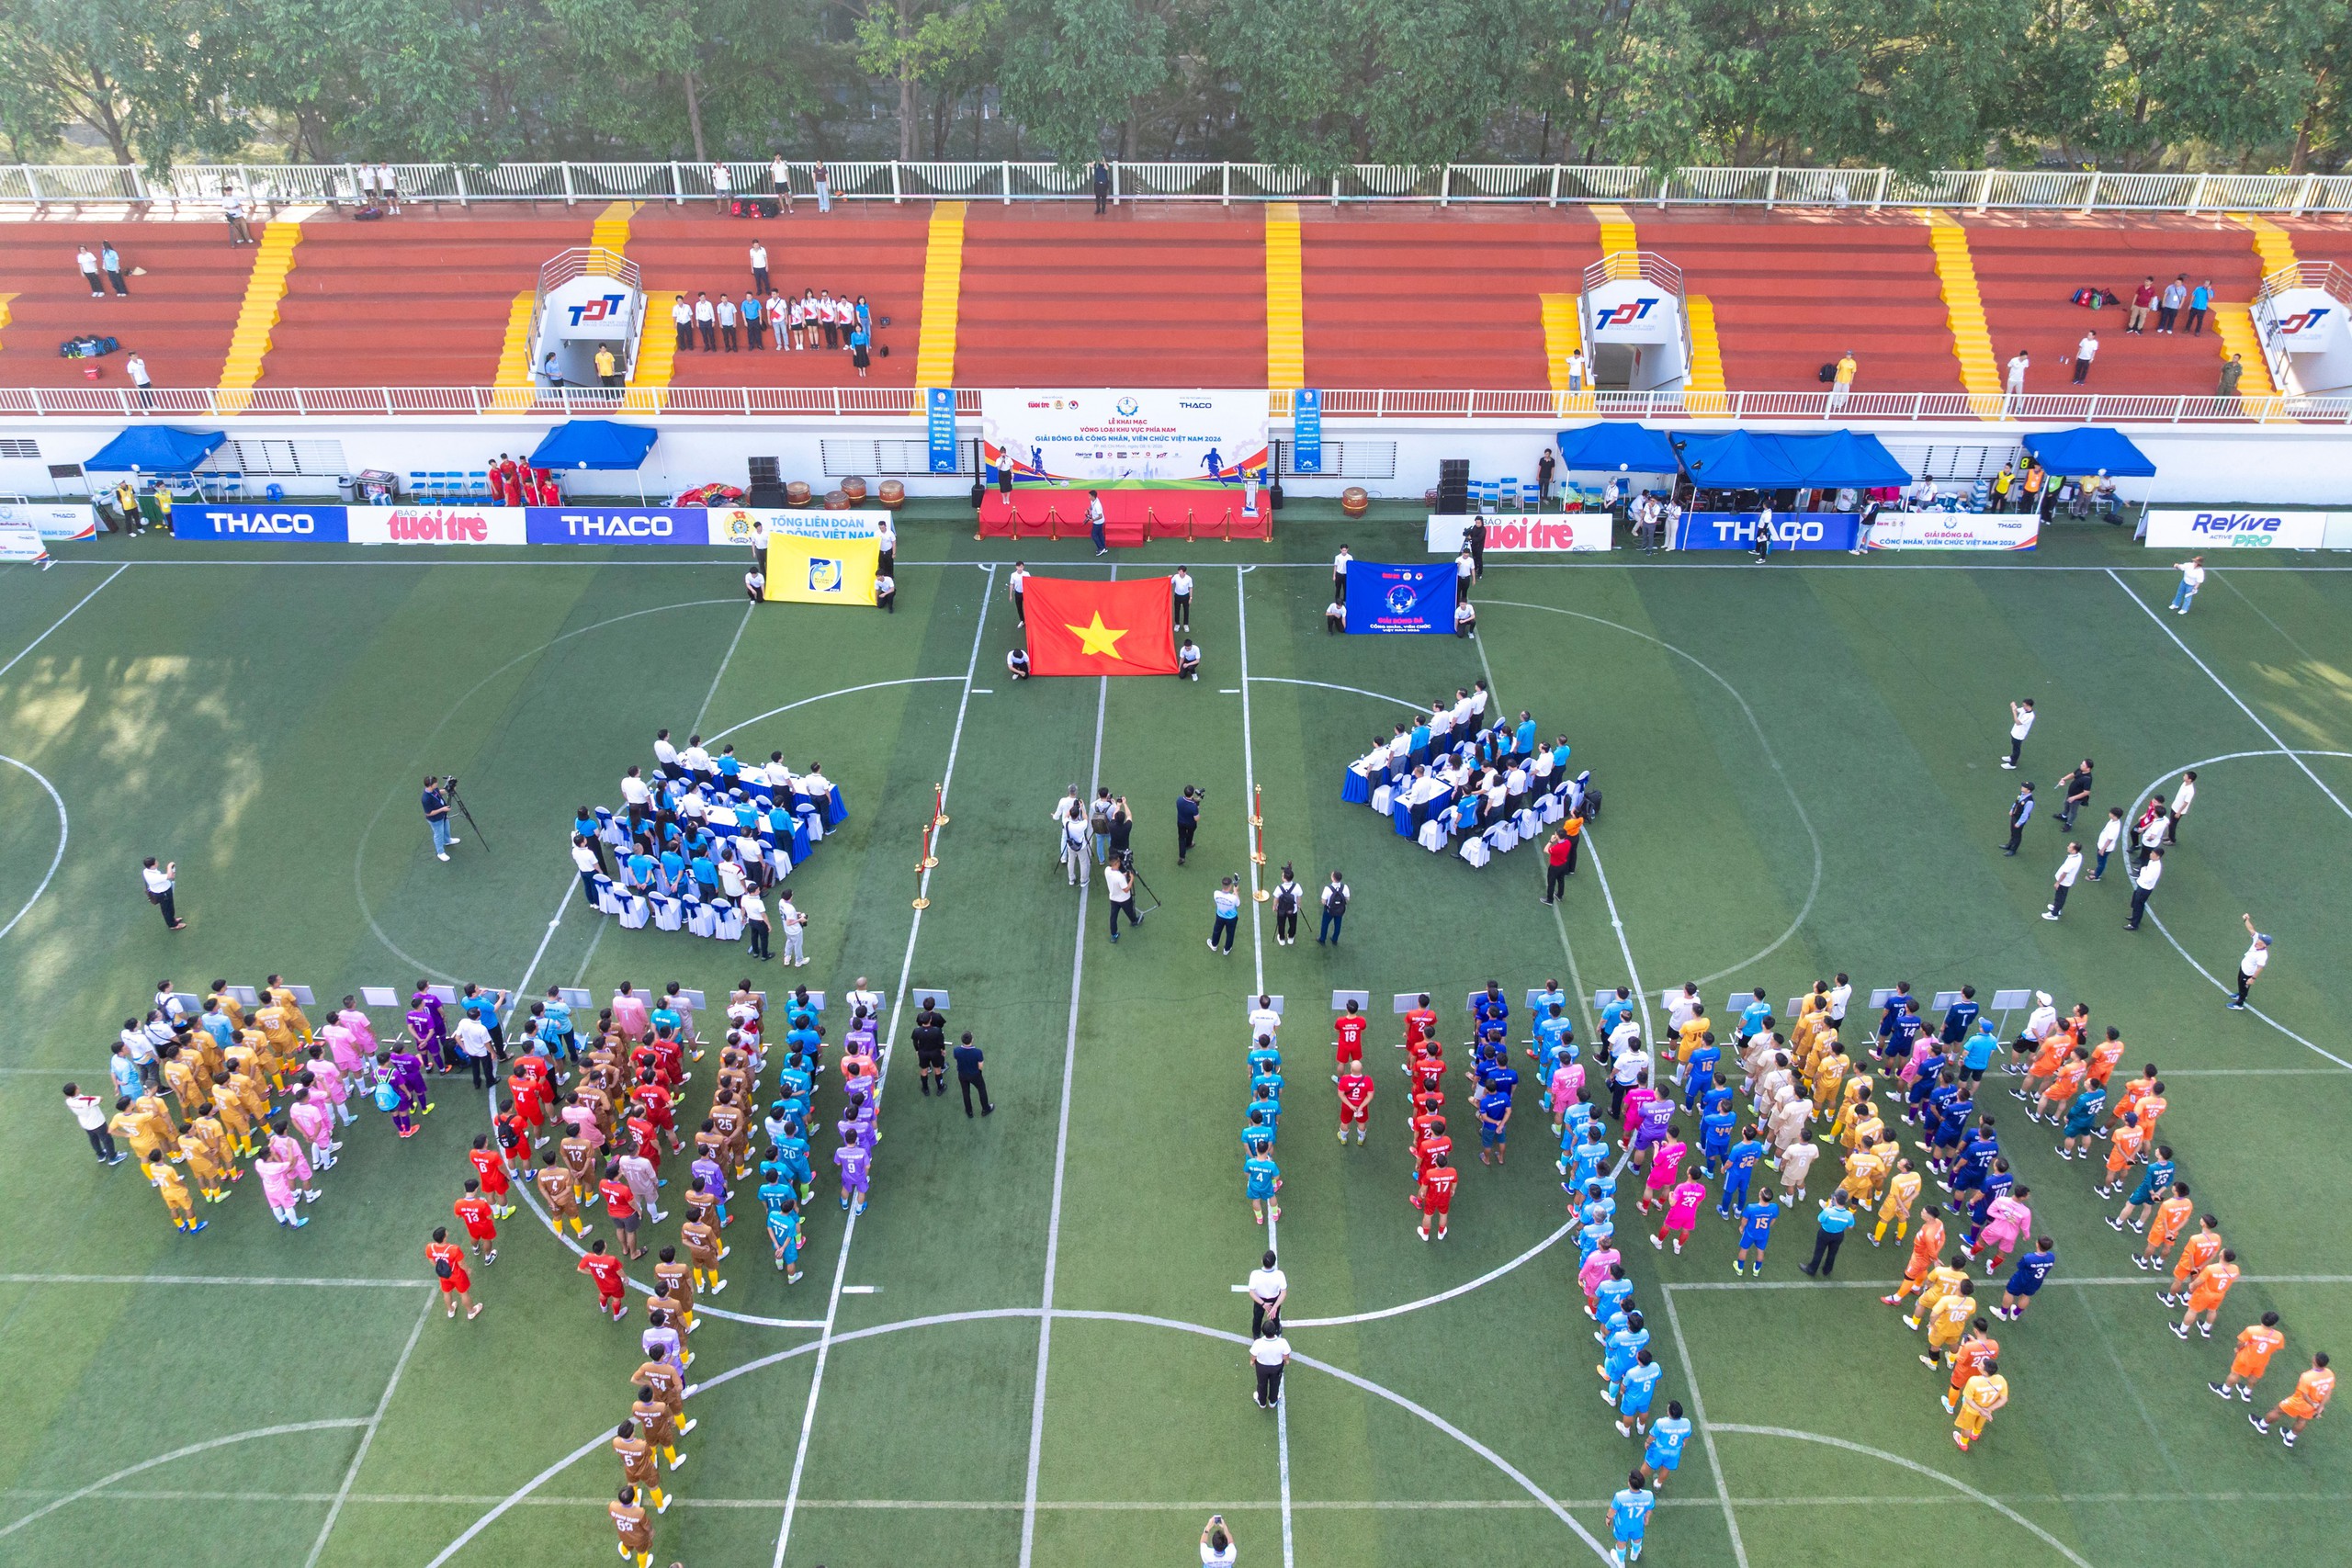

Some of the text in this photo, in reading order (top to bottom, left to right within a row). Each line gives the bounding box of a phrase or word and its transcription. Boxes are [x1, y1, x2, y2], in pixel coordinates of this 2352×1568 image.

[1108, 434, 1131, 443] NHÂN,
[1170, 434, 1186, 444] VIỆT
[397, 509, 418, 518] BÁO
[206, 512, 315, 535] THACO
[387, 509, 488, 542] tuổi trẻ
[560, 515, 673, 536] THACO
[771, 514, 865, 528] TỔNG LIÊN ĐOÀN
[1484, 516, 1574, 549] uổi trẻ
[2232, 534, 2273, 547] PRO
[1897, 1008, 1905, 1018] 8
[1962, 1014, 1968, 1025] 1
[1345, 1031, 1357, 1043] 18
[1554, 1031, 1561, 1041] 5
[1904, 1027, 1917, 1037] 14
[1702, 1061, 1713, 1072] 16
[1565, 1077, 1578, 1089] 22
[517, 1092, 526, 1103] 4
[1352, 1088, 1361, 1098] 2
[1942, 1098, 1951, 1110] 9
[1654, 1113, 1670, 1124] 99
[1958, 1114, 1966, 1124] 7
[718, 1119, 733, 1131] 25
[2128, 1137, 2140, 1148] 19
[568, 1150, 582, 1162] 12
[782, 1148, 797, 1159] 20
[1978, 1156, 1993, 1168] 13
[847, 1163, 856, 1174] 9
[1855, 1167, 1871, 1178] 07
[1256, 1172, 1263, 1182] 4
[2155, 1174, 2169, 1185] 23
[1435, 1181, 1450, 1192] 17
[608, 1195, 617, 1205] 4
[768, 1197, 781, 1207] 11
[1755, 1217, 1770, 1229] 15
[2173, 1212, 2181, 1223] 2
[773, 1225, 785, 1237] 17
[2034, 1269, 2045, 1279] 3
[2218, 1279, 2227, 1291] 6
[1612, 1293, 1622, 1303] 4
[1949, 1310, 1967, 1323] 06
[1628, 1346, 1637, 1358] 3
[2256, 1342, 2268, 1354] 9
[1643, 1381, 1651, 1393] 6
[1981, 1392, 1997, 1404] 17
[644, 1417, 653, 1427] 3
[1668, 1434, 1679, 1446] 8
[624, 1455, 634, 1467] 5
[1627, 1506, 1645, 1518] 17
